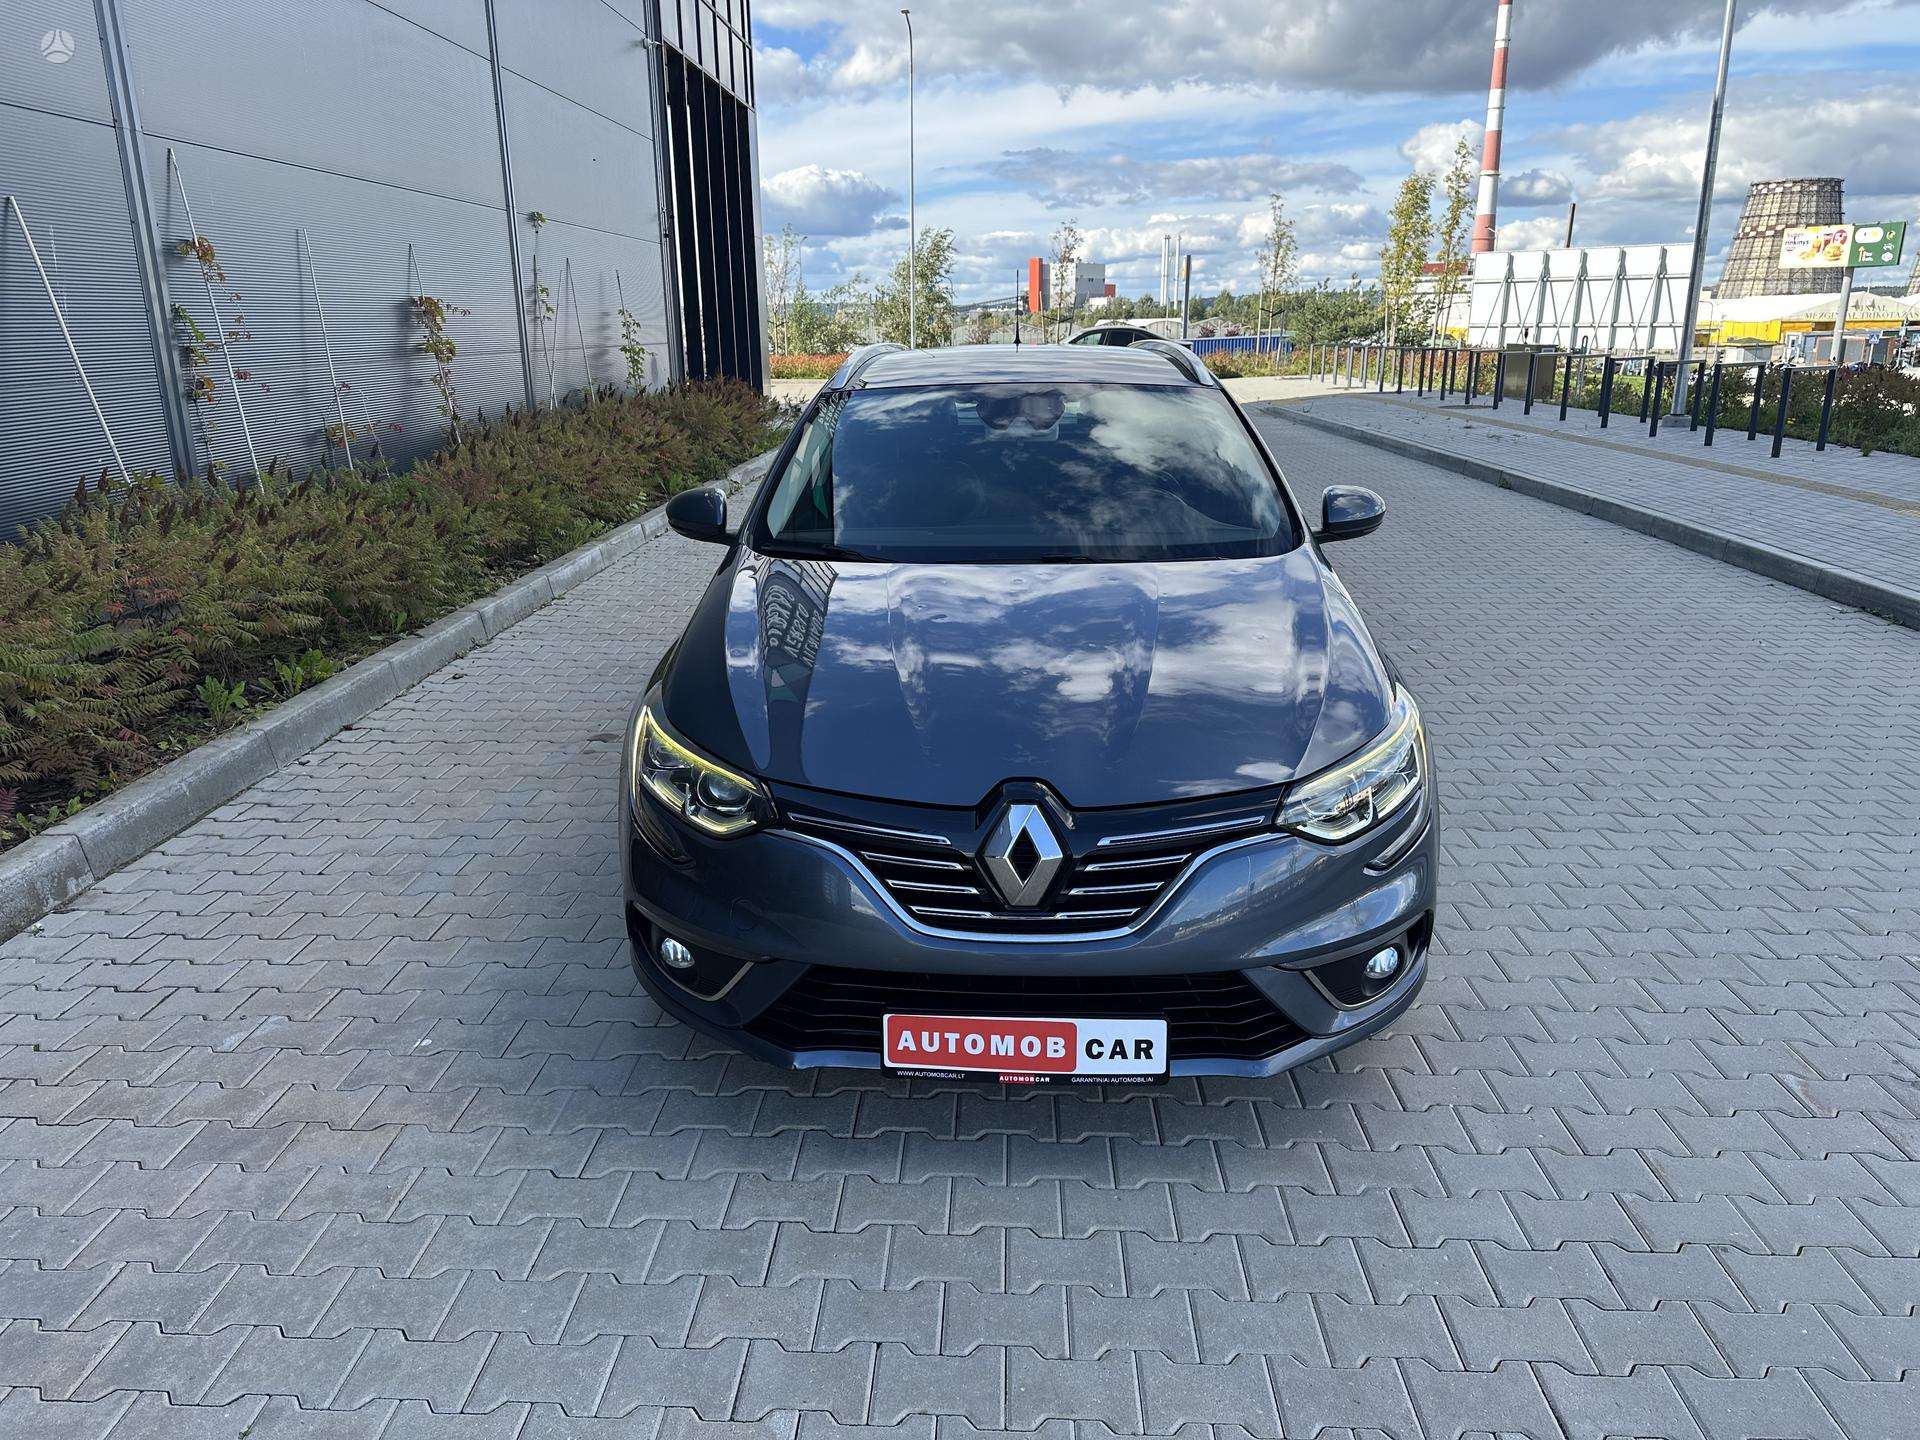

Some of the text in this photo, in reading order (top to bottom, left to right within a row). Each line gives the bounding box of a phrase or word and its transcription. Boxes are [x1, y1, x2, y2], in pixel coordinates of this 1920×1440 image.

[897, 1030, 1154, 1060] AUTOMOB CAR
[897, 1070, 966, 1079] WWW.AUTOMOBCAR.LT
